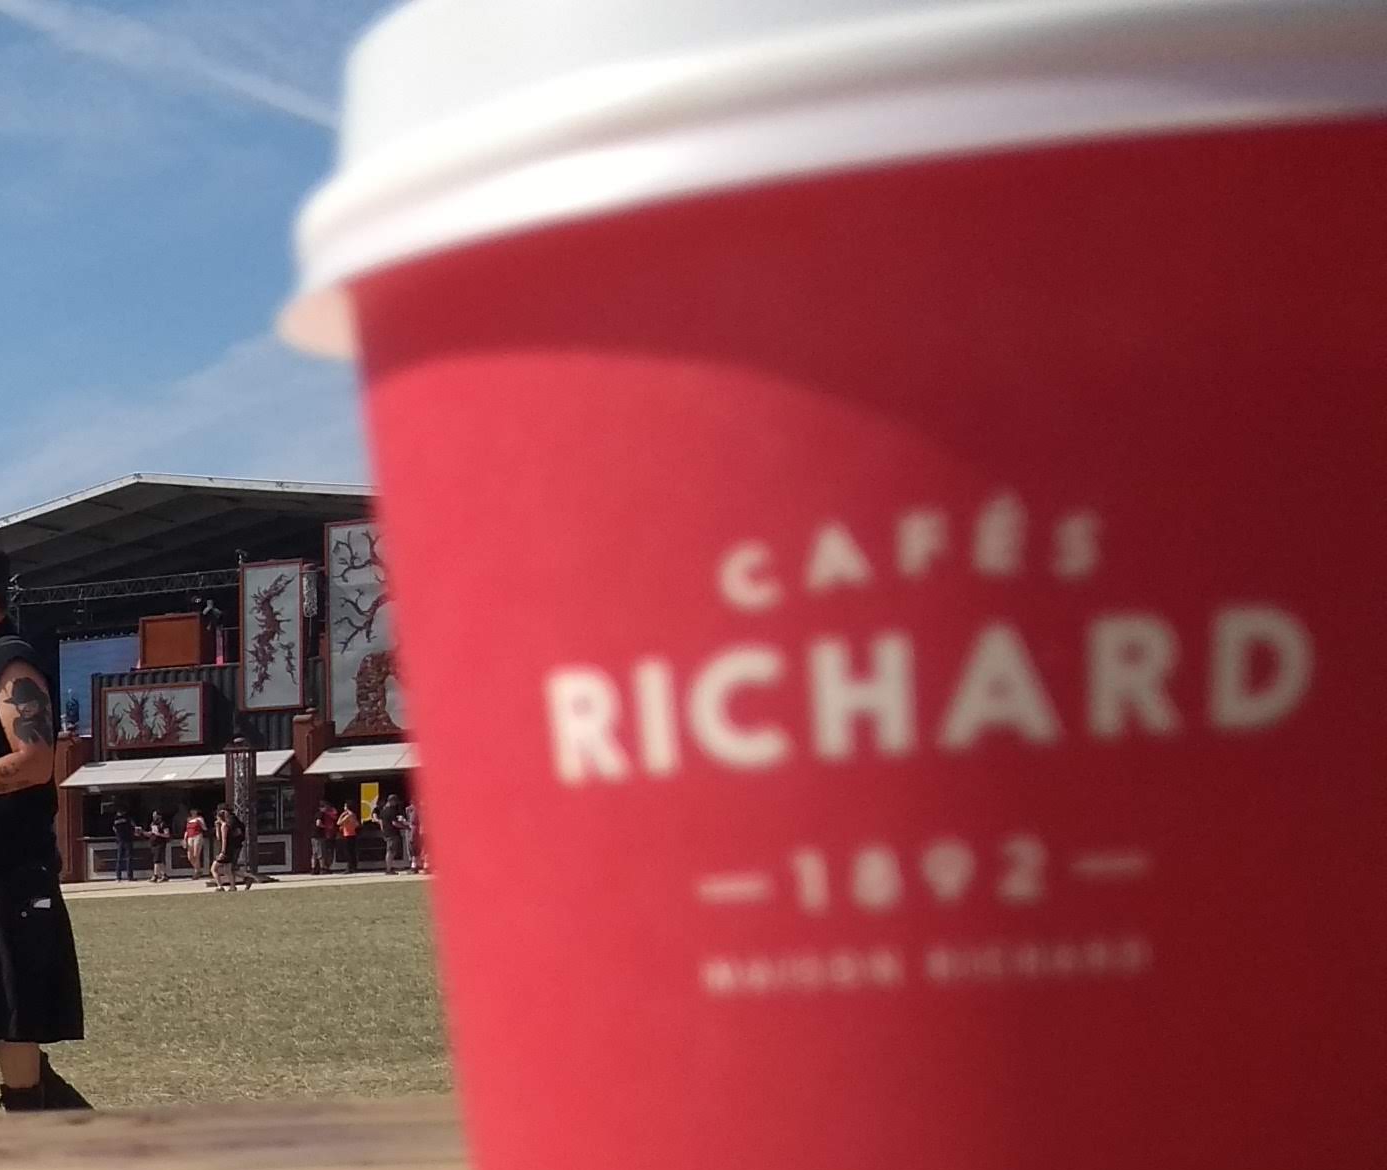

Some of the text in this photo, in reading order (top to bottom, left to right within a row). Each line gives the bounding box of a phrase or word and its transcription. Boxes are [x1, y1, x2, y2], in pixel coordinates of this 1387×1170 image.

[716, 492, 1102, 612] CAFÉS
[544, 602, 1315, 785] RICHARD
[788, 835, 1047, 912] 1892
